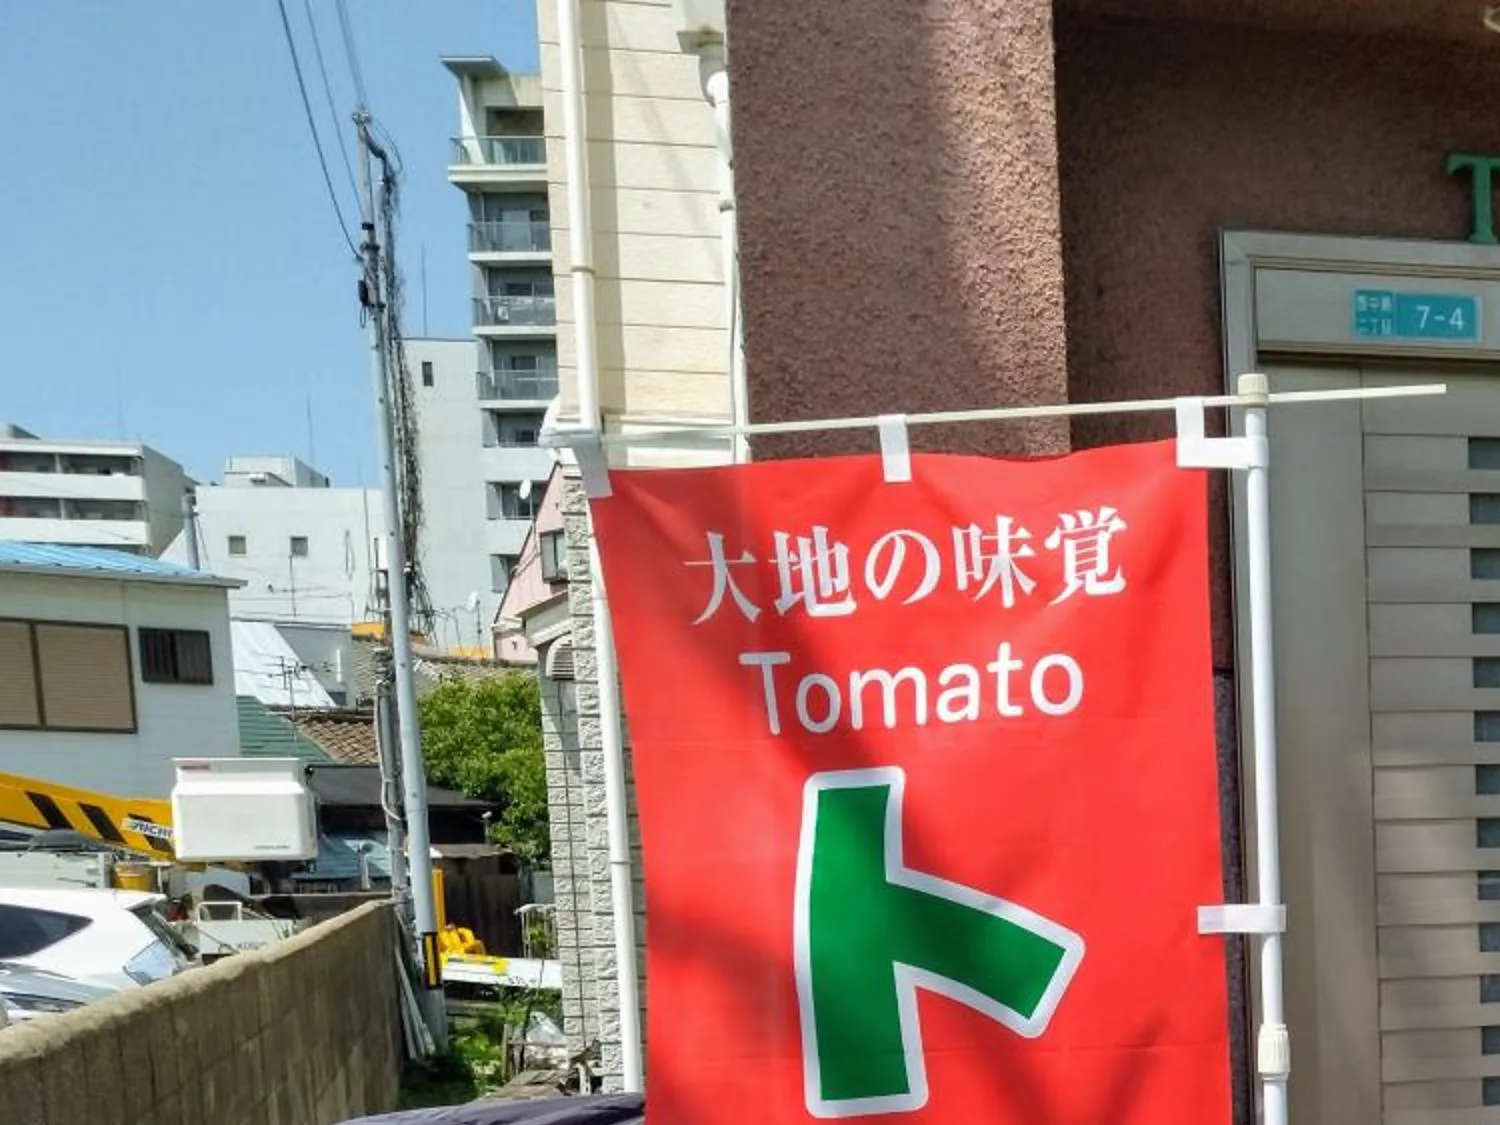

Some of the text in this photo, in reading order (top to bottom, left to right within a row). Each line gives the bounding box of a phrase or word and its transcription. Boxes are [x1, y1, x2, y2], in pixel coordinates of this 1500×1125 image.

[1415, 305, 1465, 331] 7-4
[684, 505, 1128, 625] 大地の味覚
[739, 641, 1084, 736] Tomato
